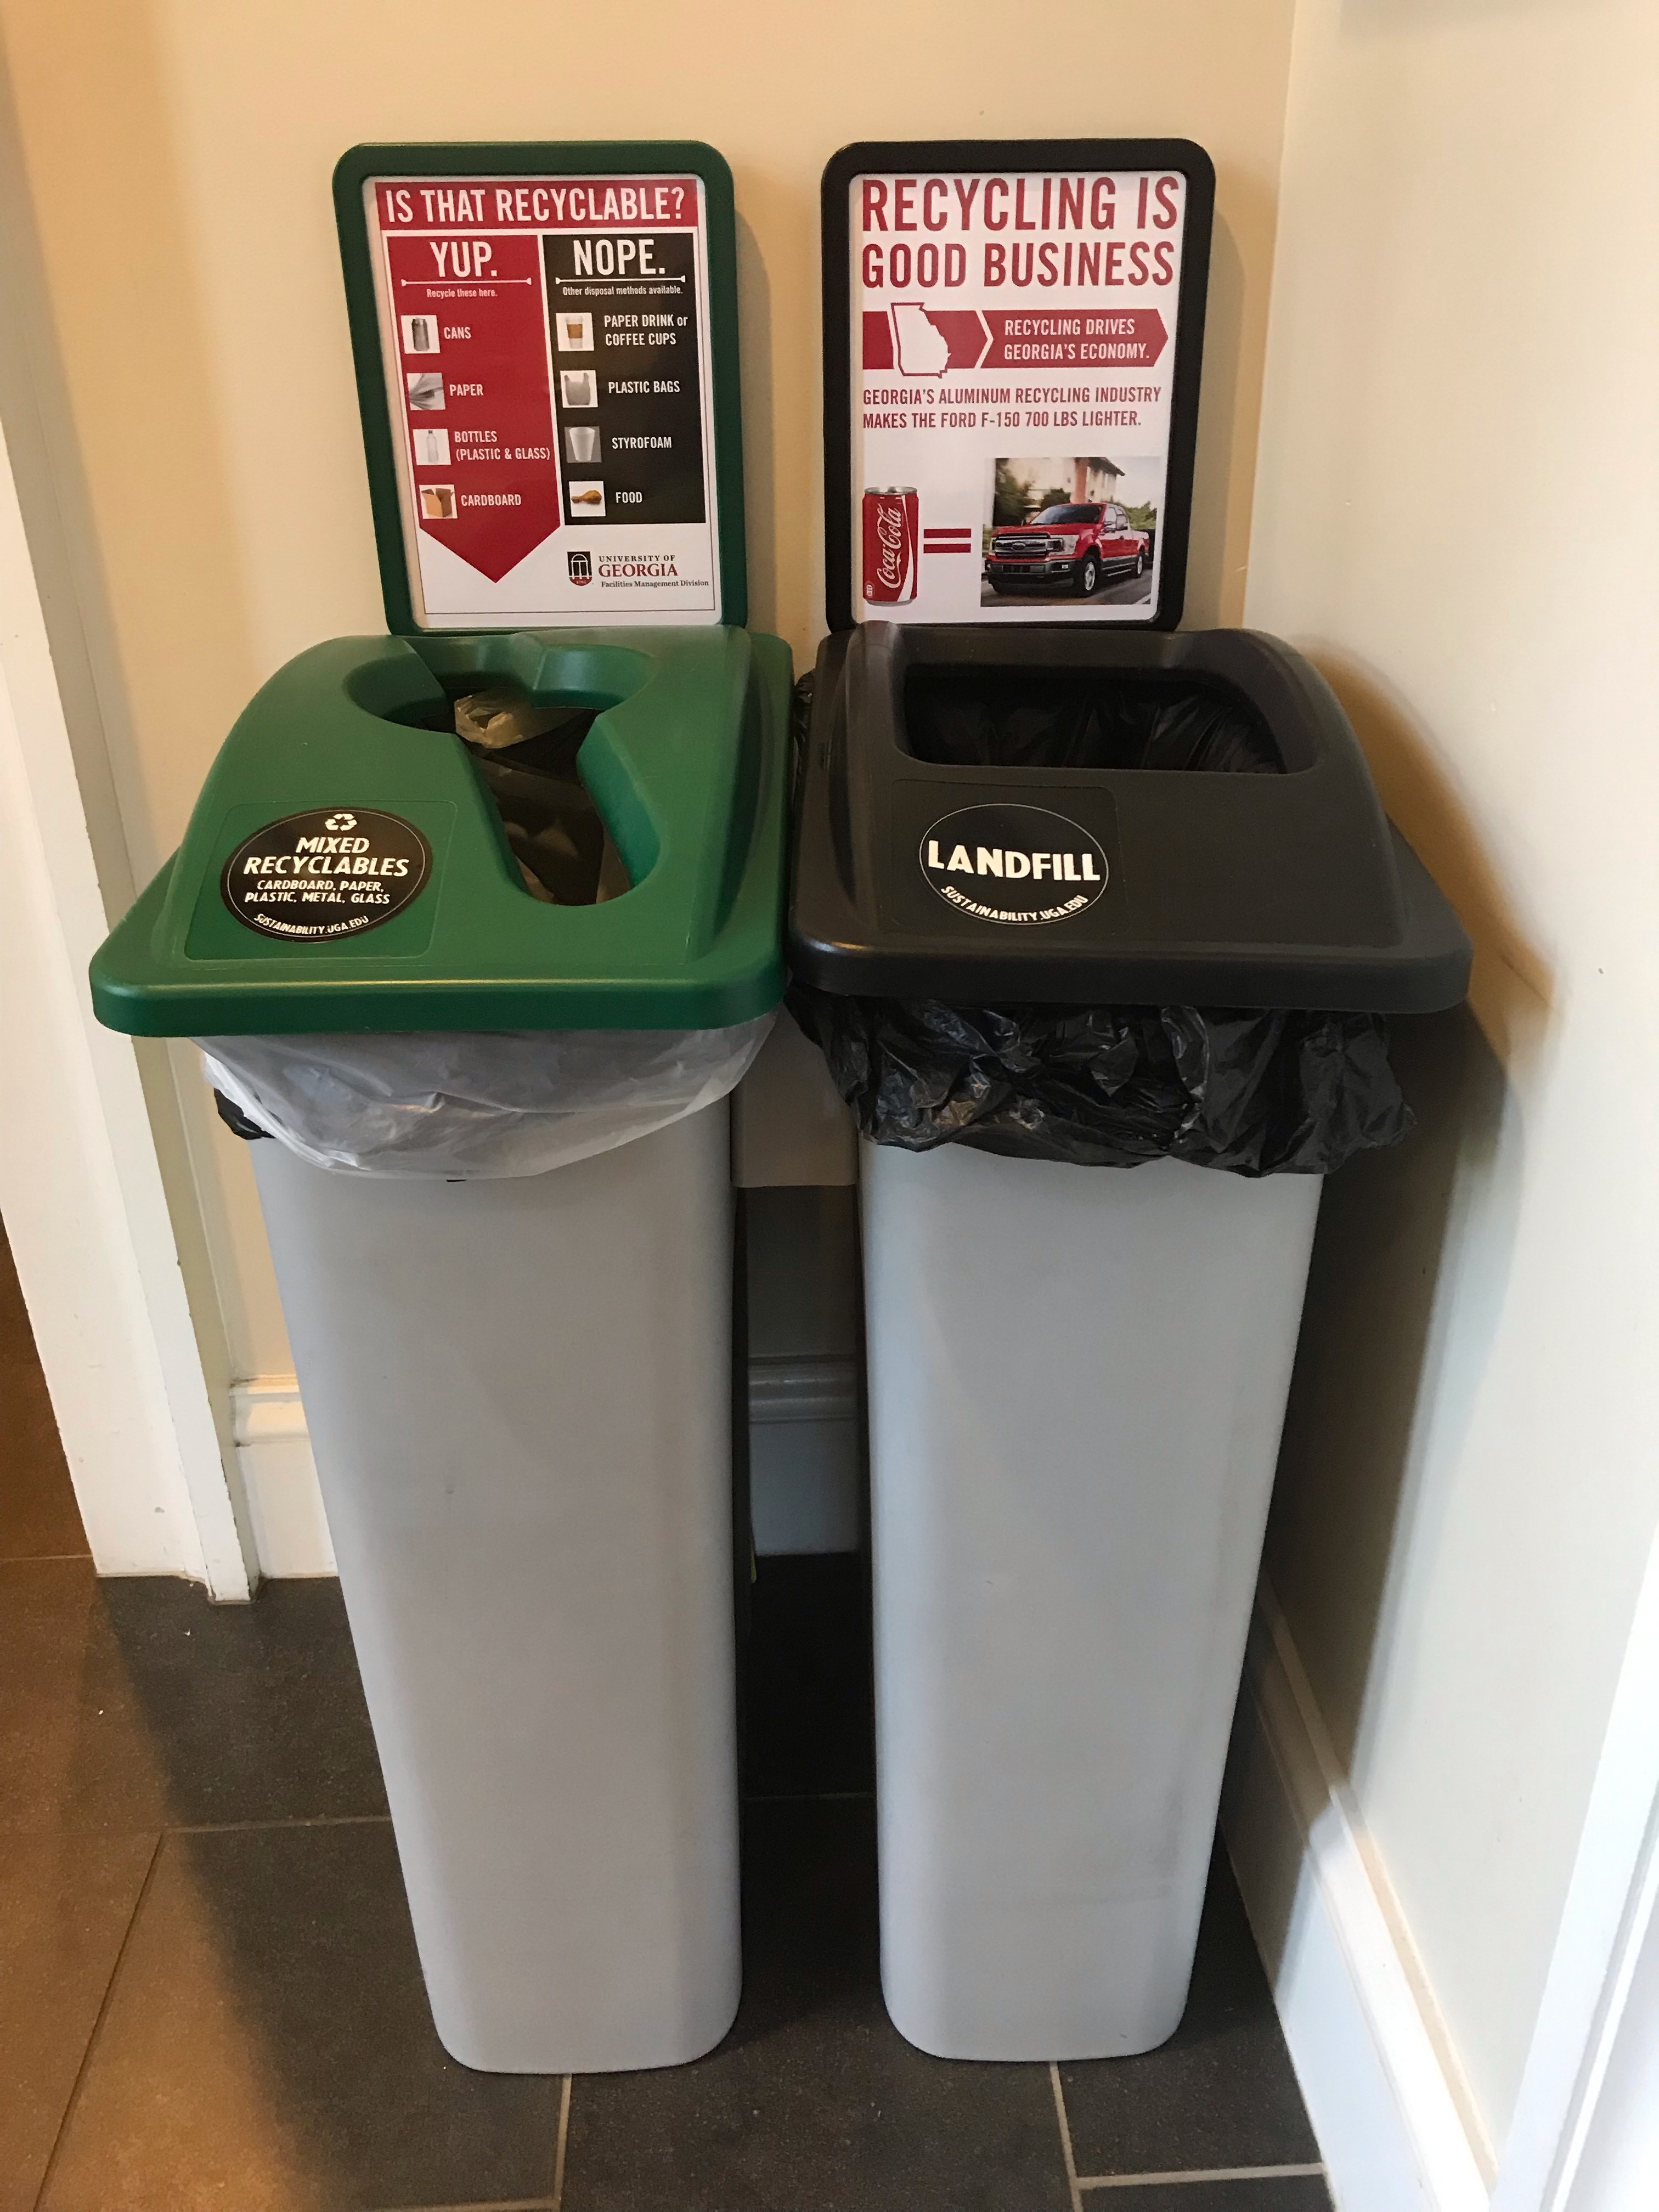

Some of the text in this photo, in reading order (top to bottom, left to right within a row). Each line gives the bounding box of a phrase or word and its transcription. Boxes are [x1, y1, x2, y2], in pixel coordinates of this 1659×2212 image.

[386, 187, 684, 222] IS THAT RECYCLABLE?
[862, 177, 1179, 232] RECYCLING IS
[430, 240, 496, 276] YUP.
[573, 239, 665, 275] NOPE.
[862, 241, 1174, 288] GOOD BUSINESS
[427, 289, 498, 298] Recycle these here.
[563, 286, 683, 296] Other disposal methods available.
[604, 315, 688, 327] PAPER DRINK or
[1005, 318, 1135, 336] RECYCLING DRIVES
[443, 327, 471, 340] CANS
[605, 333, 676, 346] COFFEE CUPS
[1005, 343, 1150, 360] GEORGIA'S ECONOMY.
[450, 384, 484, 396] PAPER
[608, 381, 680, 393] PLASTIC BAGS
[863, 387, 1162, 405] GEORGIA'S ALUMINUM RECYCLING INDUSTRY
[863, 410, 1141, 428] MAKES THE FORD F-150 700 LBS LIGHTER.
[455, 431, 497, 443] BOTTLES
[612, 437, 672, 449] STYROFOAM
[456, 447, 550, 461] (PLASTIC & GLASS)
[461, 494, 521, 506] CARDBOARD
[616, 492, 642, 504] FOOD
[598, 563, 678, 577] GEORGIA
[296, 837, 370, 854] MIXED
[243, 856, 409, 877] RECYCLABLES
[928, 840, 1101, 881] LANDFILL
[257, 880, 384, 892] CARDBOARD, PAPER,
[245, 892, 390, 904] PLASTIC, METAL, GLASS
[941, 885, 1088, 921] SUSTAINABILITY.UGA.EDU
[253, 913, 369, 934] SUSTAINABILITY.UGA.EDU
